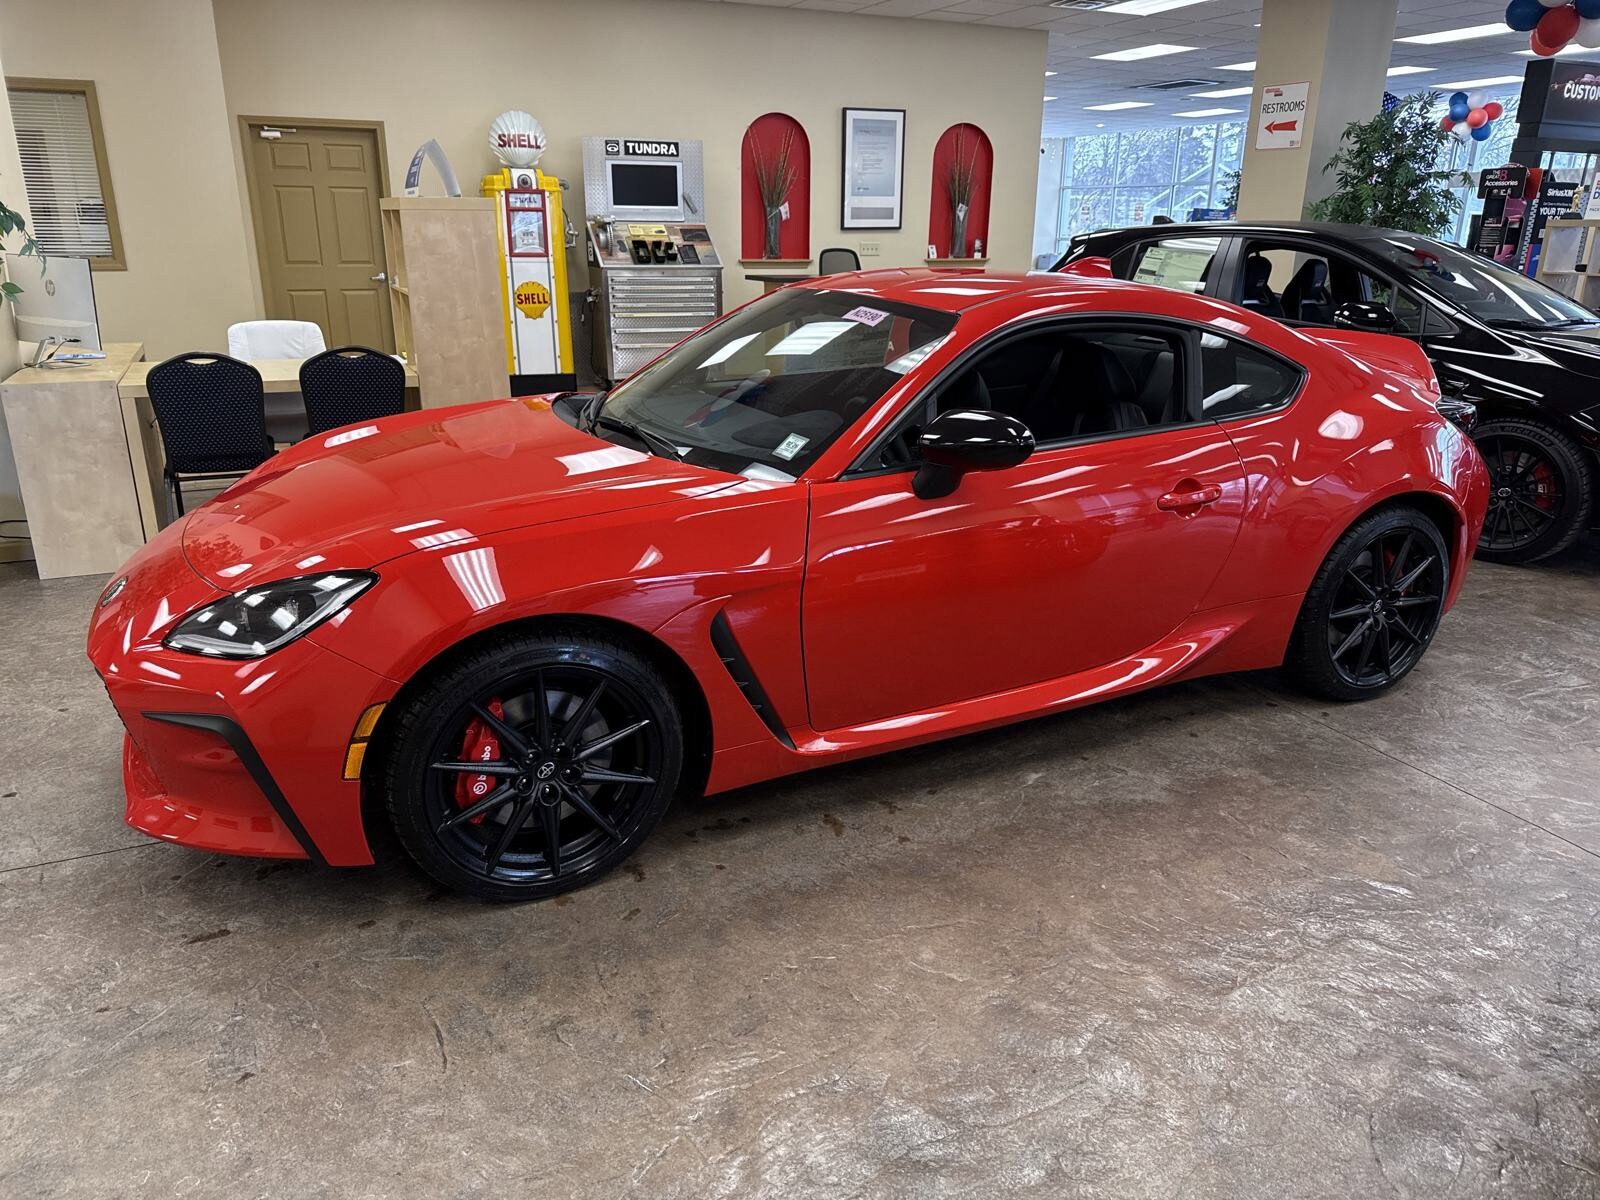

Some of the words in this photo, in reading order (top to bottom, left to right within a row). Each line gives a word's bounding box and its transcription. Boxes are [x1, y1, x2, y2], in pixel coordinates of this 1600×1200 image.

[1262, 100, 1305, 114] RESTROOMS
[497, 133, 541, 150] SHELL
[626, 142, 677, 155] TUNDRA
[1484, 179, 1519, 187] Accessories
[1540, 207, 1557, 216] YOUR
[516, 293, 549, 305] SHELL
[477, 745, 491, 781] bbo
